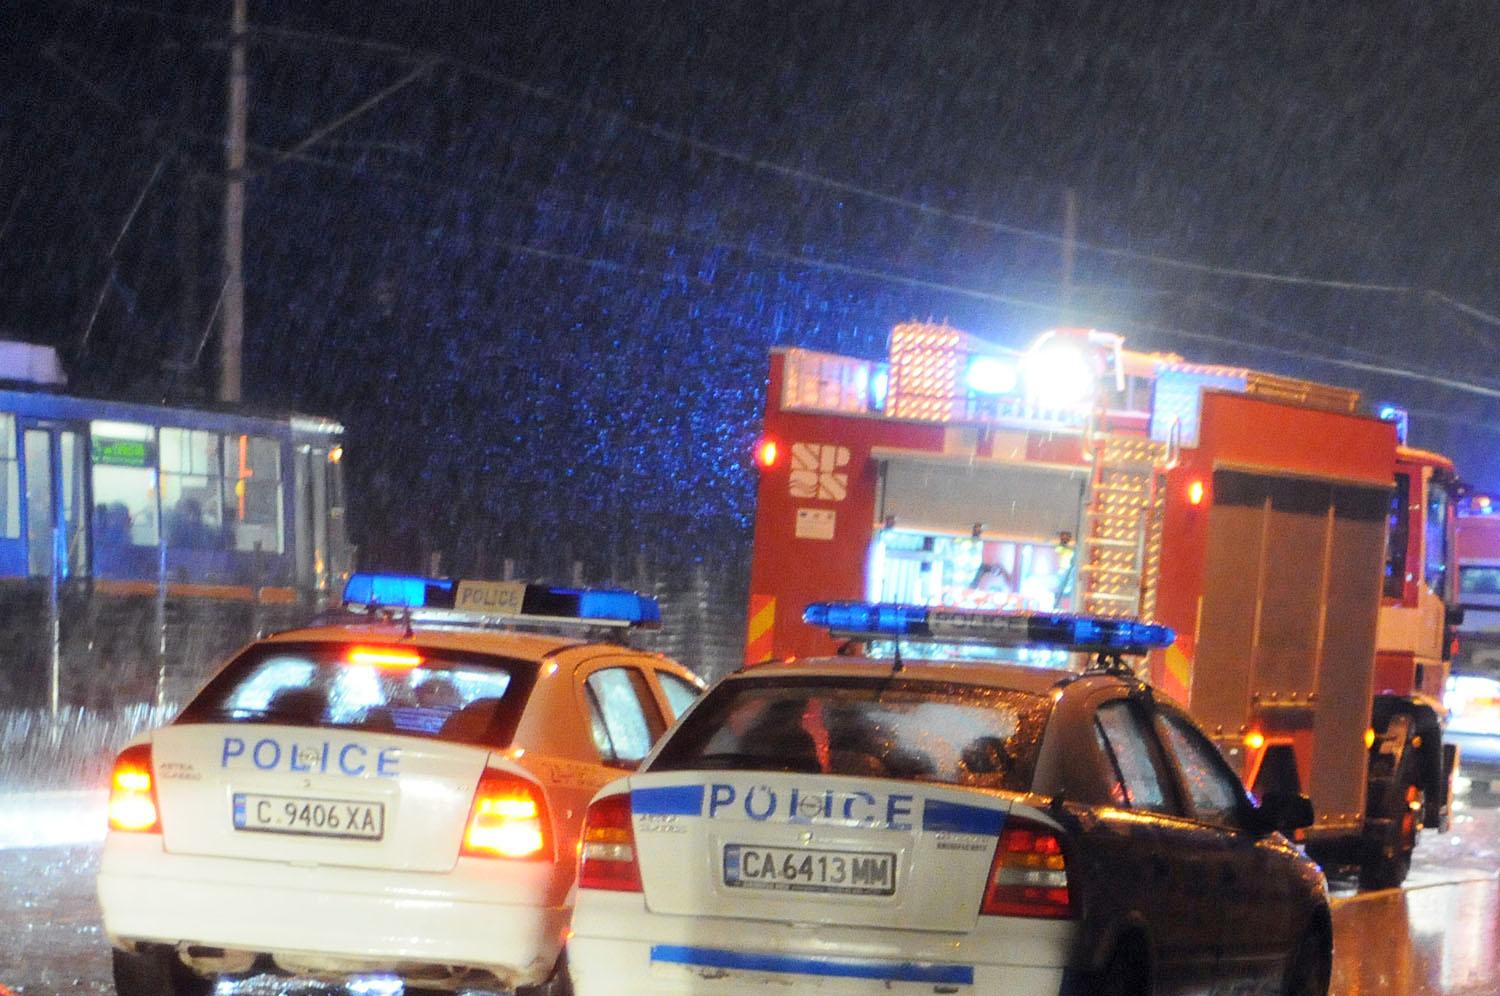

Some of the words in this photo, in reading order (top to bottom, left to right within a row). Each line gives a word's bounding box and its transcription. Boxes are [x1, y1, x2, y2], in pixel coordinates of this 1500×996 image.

[461, 587, 518, 607] POLICE
[221, 737, 402, 778] POLICE
[257, 800, 271, 824] C
[284, 802, 340, 829] 9406
[346, 806, 376, 832] XA
[709, 784, 913, 831] POLICE
[743, 851, 776, 879] CA
[783, 853, 847, 884] 6413
[852, 857, 889, 886] MM
